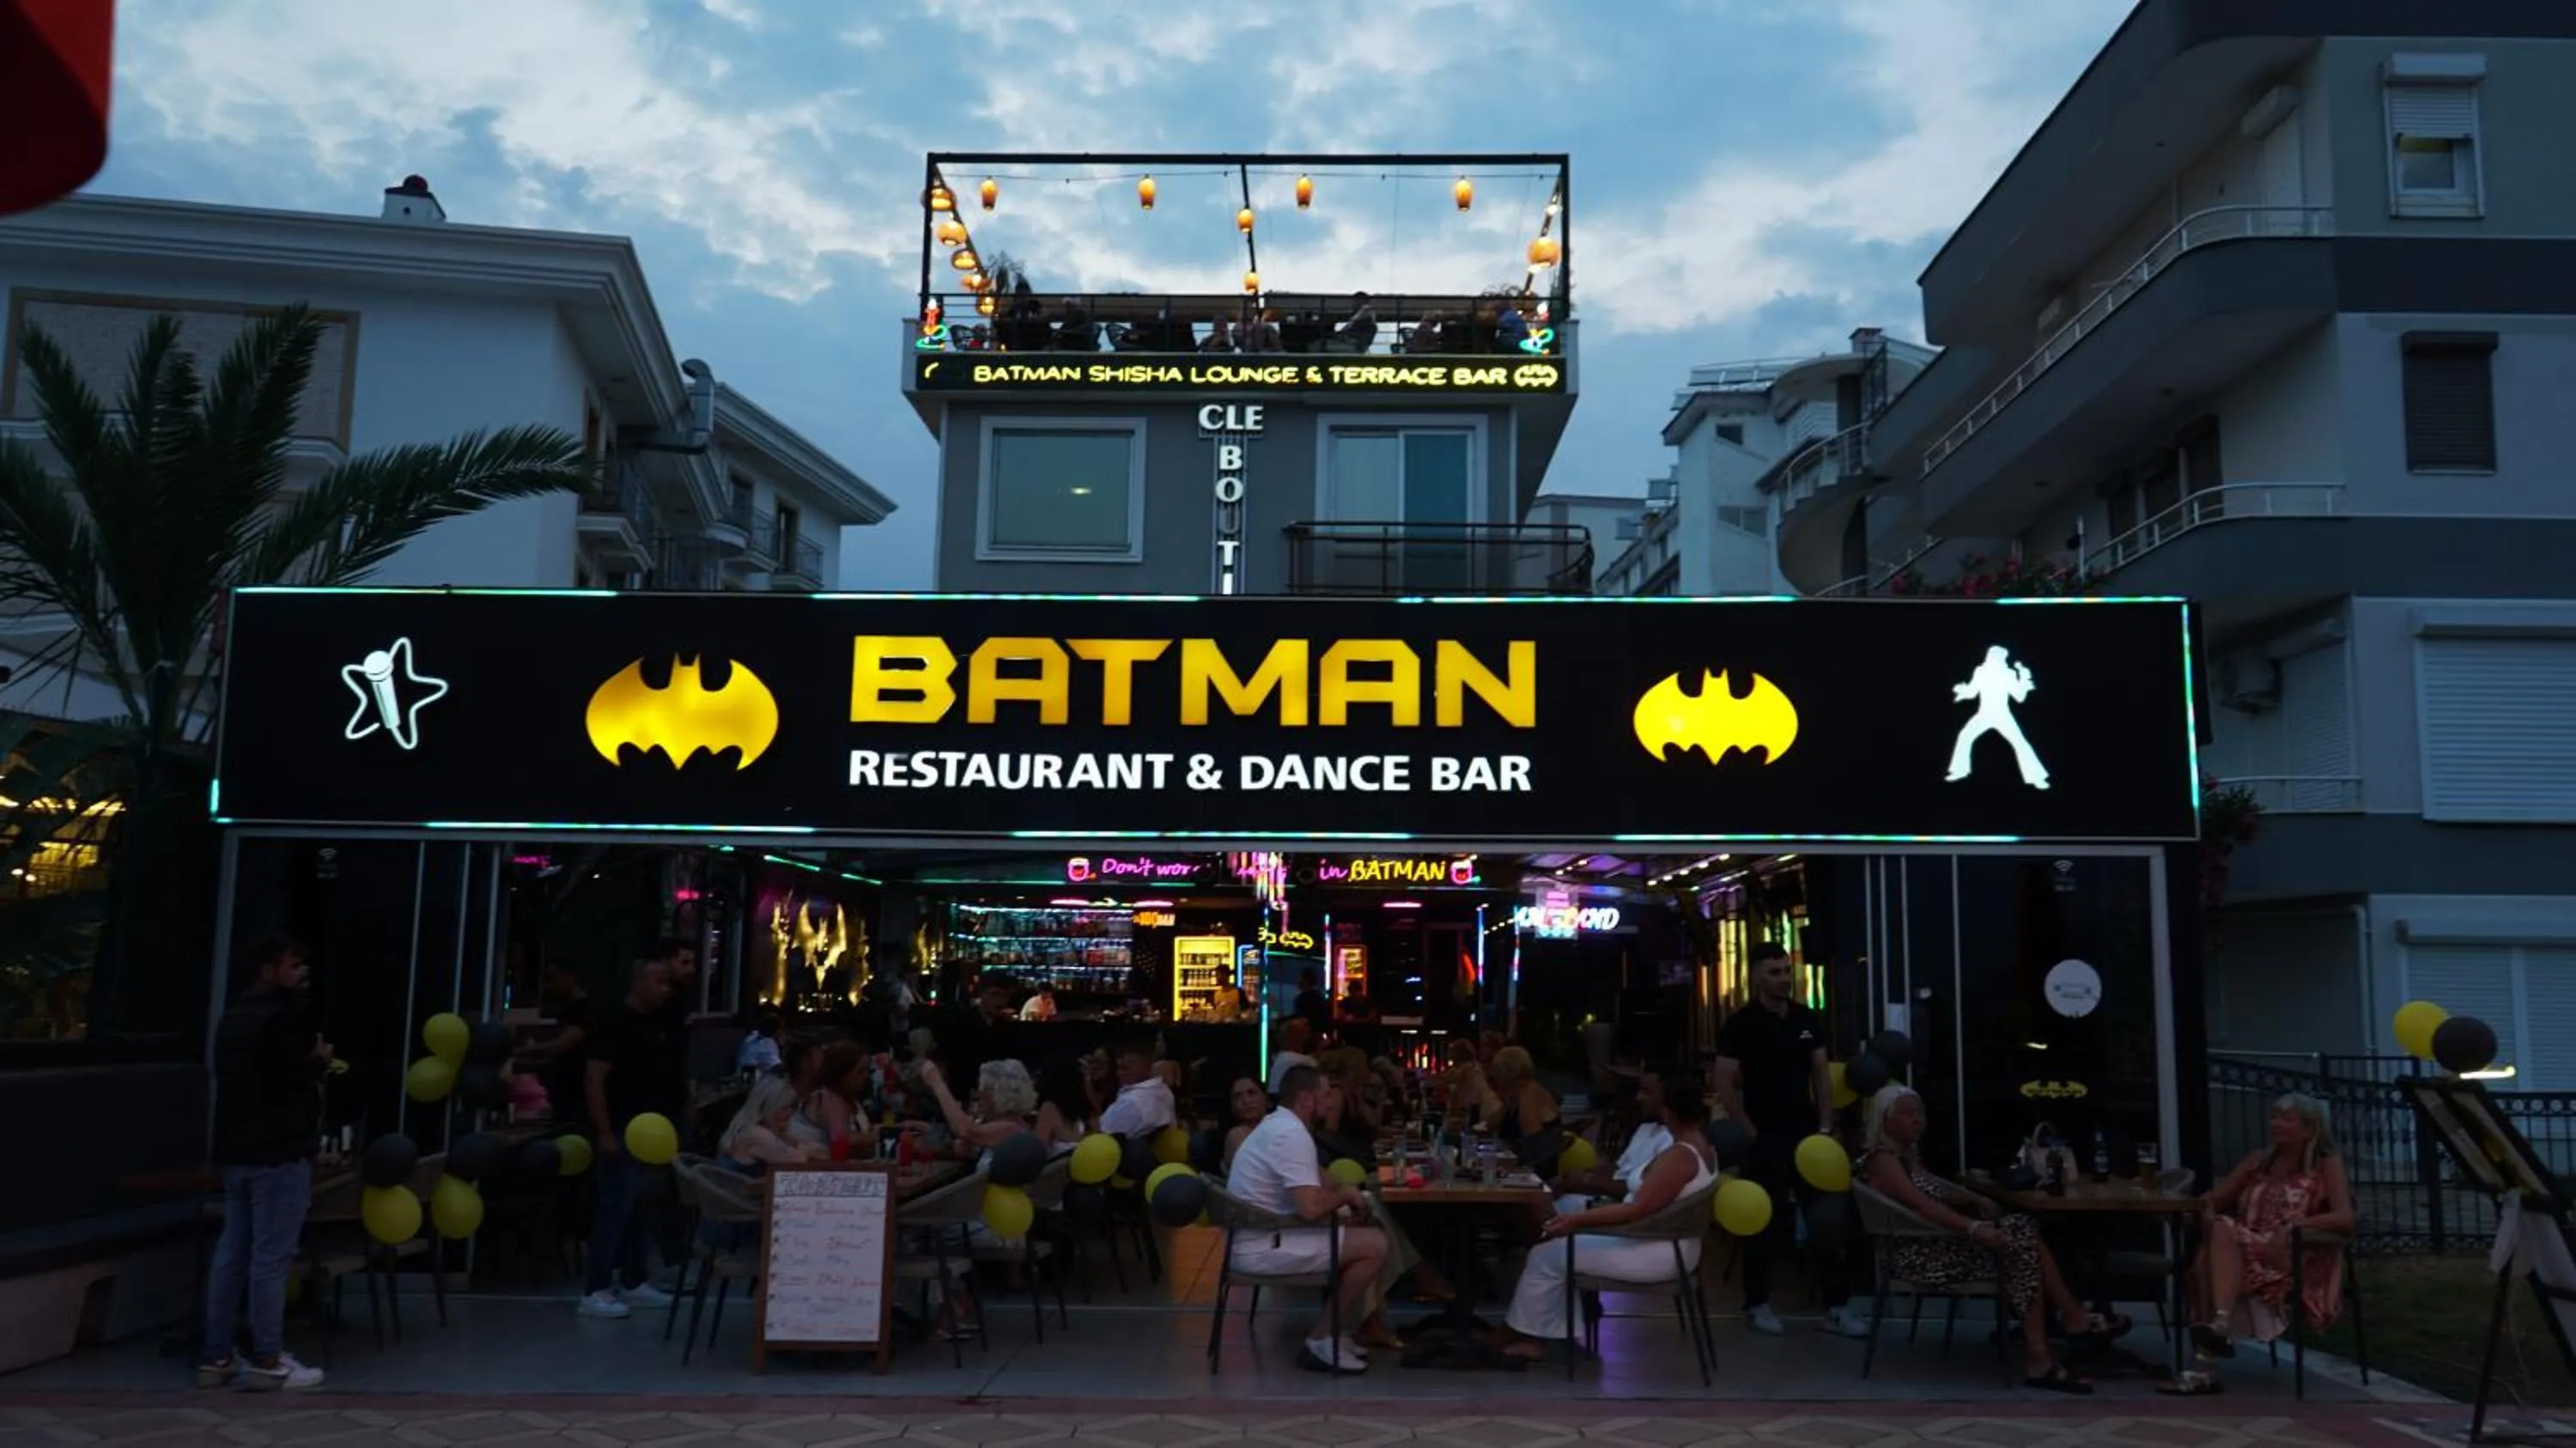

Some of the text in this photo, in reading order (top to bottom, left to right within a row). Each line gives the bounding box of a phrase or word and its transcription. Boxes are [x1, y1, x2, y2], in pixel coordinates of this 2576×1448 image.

[973, 365, 1508, 386] BATMAN SHISHA LOUNGE & TERRACE BAR
[1199, 405, 1264, 430] CLE
[849, 635, 1536, 728] BATMAN
[848, 749, 1532, 792] RESTAURANT & DANCE BAR
[1102, 857, 1154, 876] Don't
[1318, 857, 1347, 881] in
[1347, 859, 1446, 883] BATMAN
